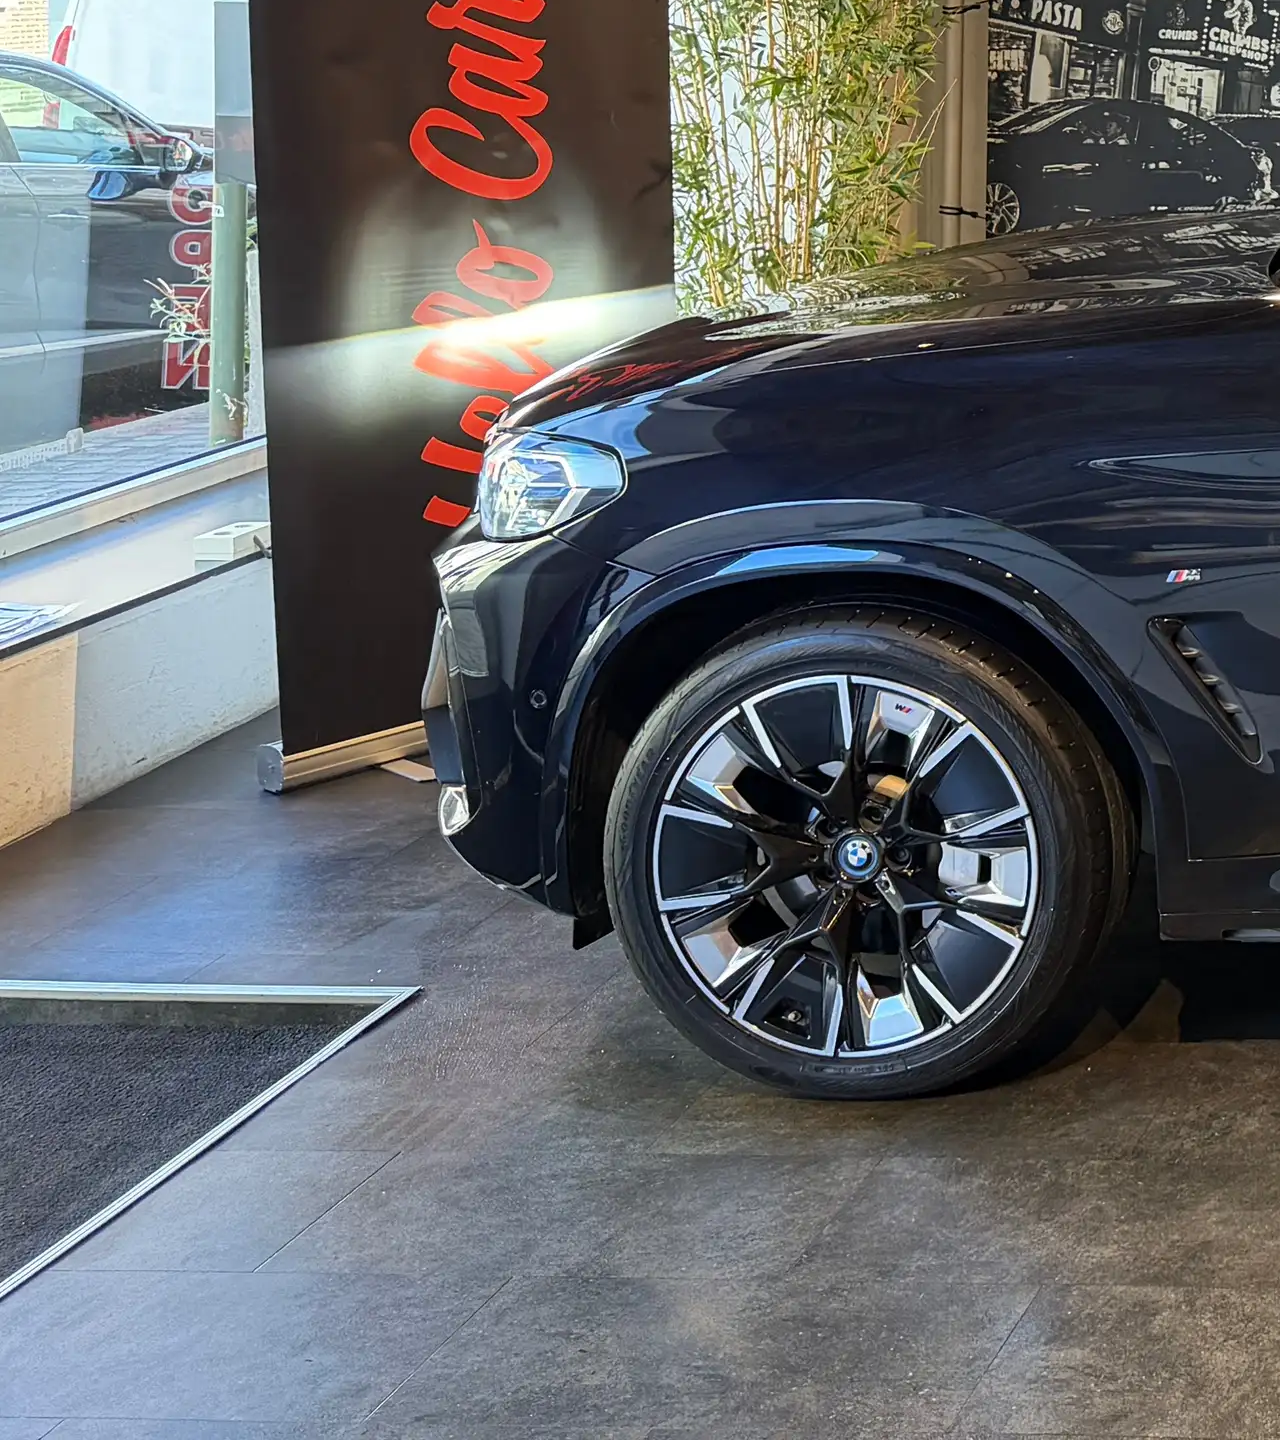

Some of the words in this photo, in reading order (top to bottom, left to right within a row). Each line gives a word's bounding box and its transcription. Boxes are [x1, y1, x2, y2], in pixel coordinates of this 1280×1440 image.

[1158, 28, 1198, 41] CRUMBS
[1209, 27, 1270, 53] CRUMBS
[1241, 49, 1268, 63] SHOP
